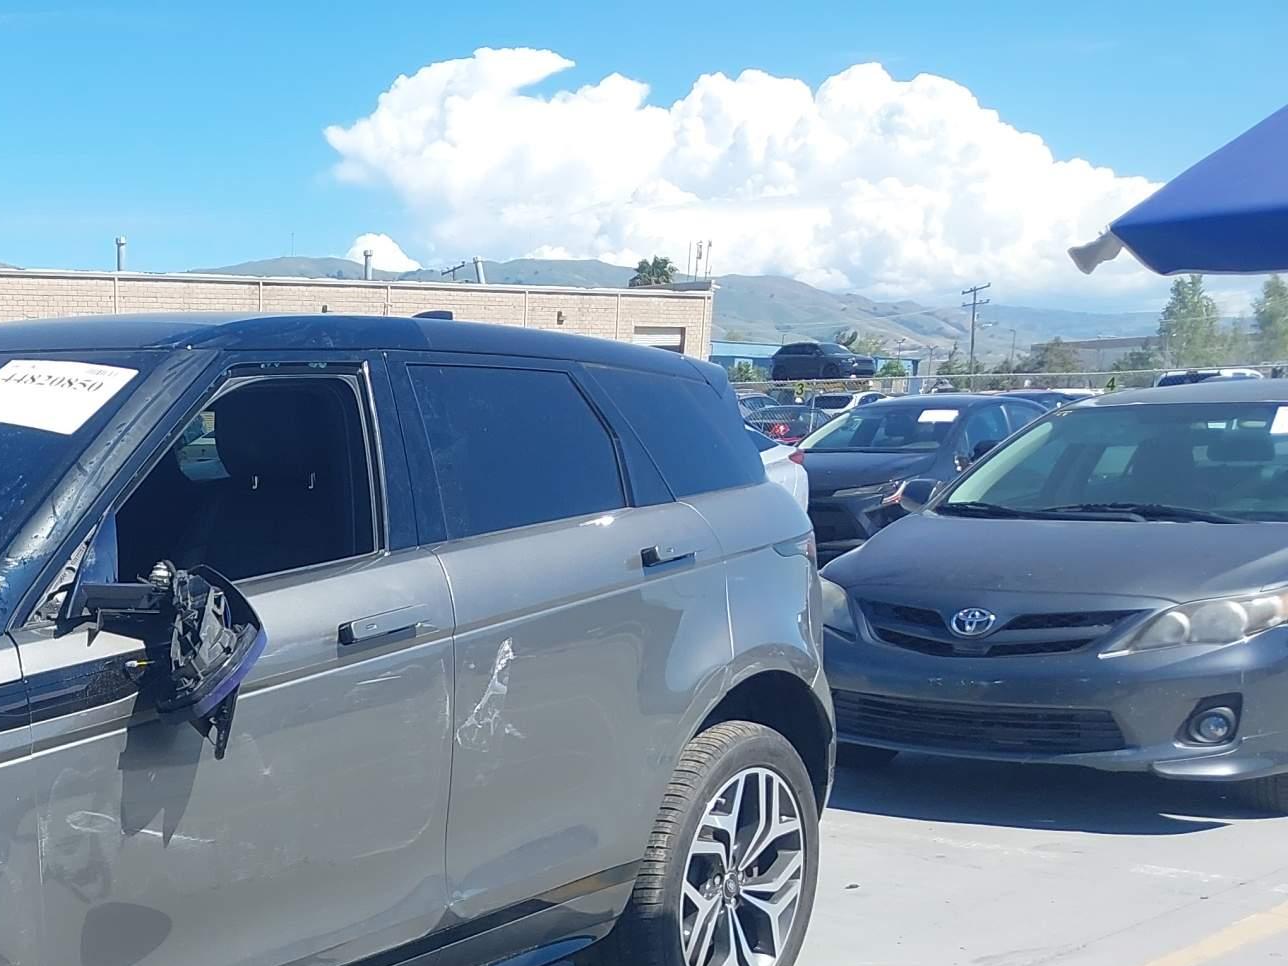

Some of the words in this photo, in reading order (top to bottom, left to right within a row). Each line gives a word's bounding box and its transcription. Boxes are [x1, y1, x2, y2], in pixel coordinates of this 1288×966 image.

[1, 372, 105, 393] 44820850
[796, 382, 805, 395] 3
[1106, 376, 1116, 391] 4
